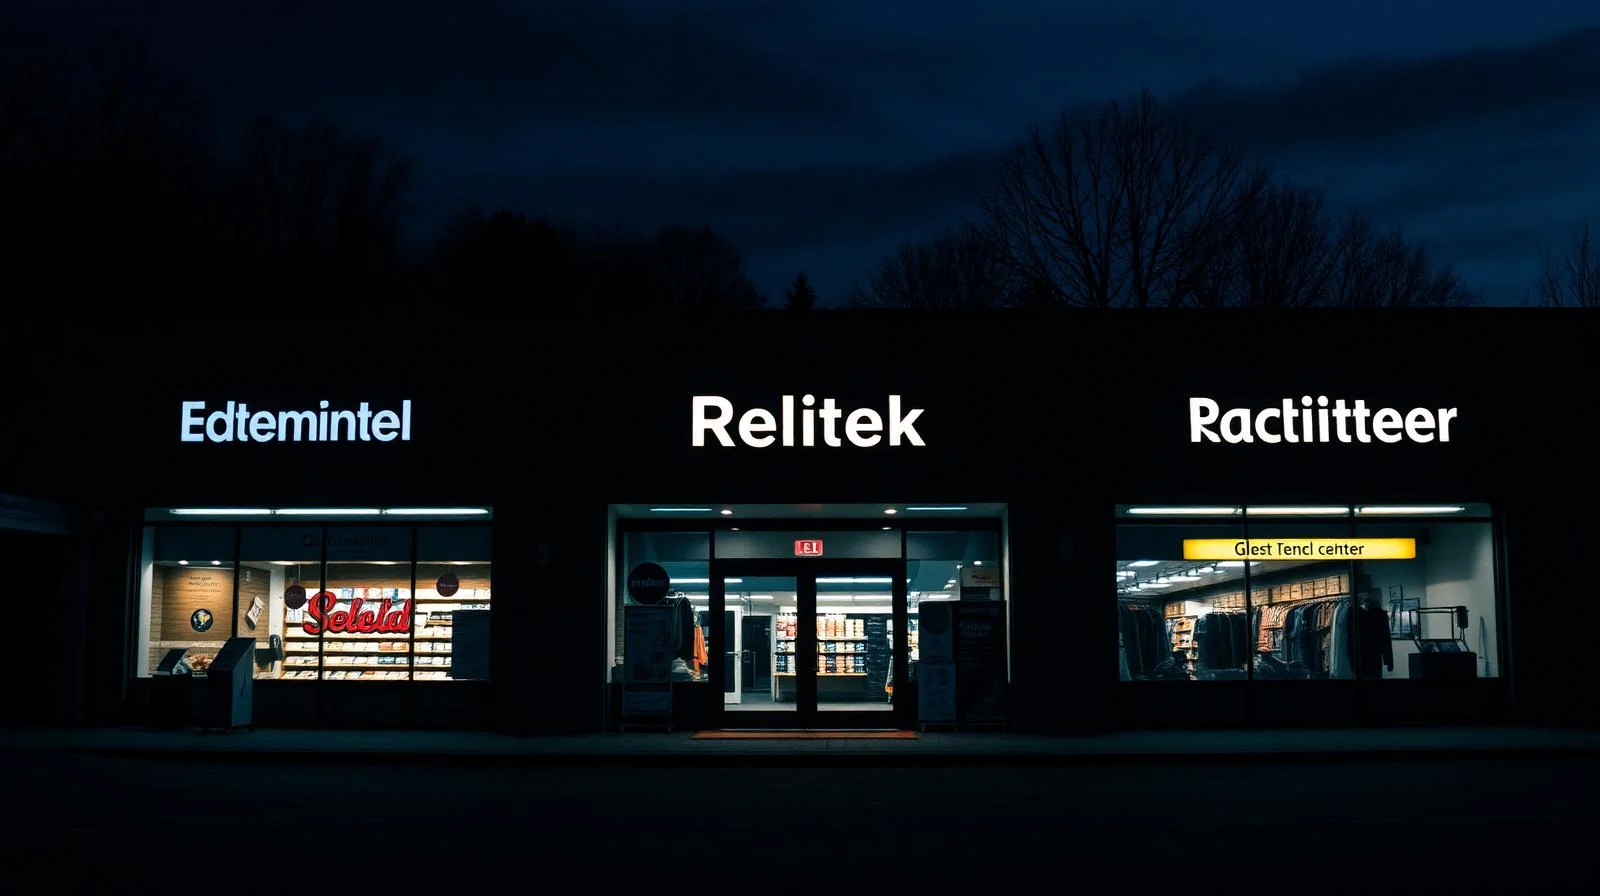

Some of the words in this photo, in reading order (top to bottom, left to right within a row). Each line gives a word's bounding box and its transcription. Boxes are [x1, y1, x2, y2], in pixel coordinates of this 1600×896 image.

[181, 400, 411, 442] Edtemintel
[692, 394, 925, 447] Relitek
[1190, 396, 1458, 443] Ractiitteer
